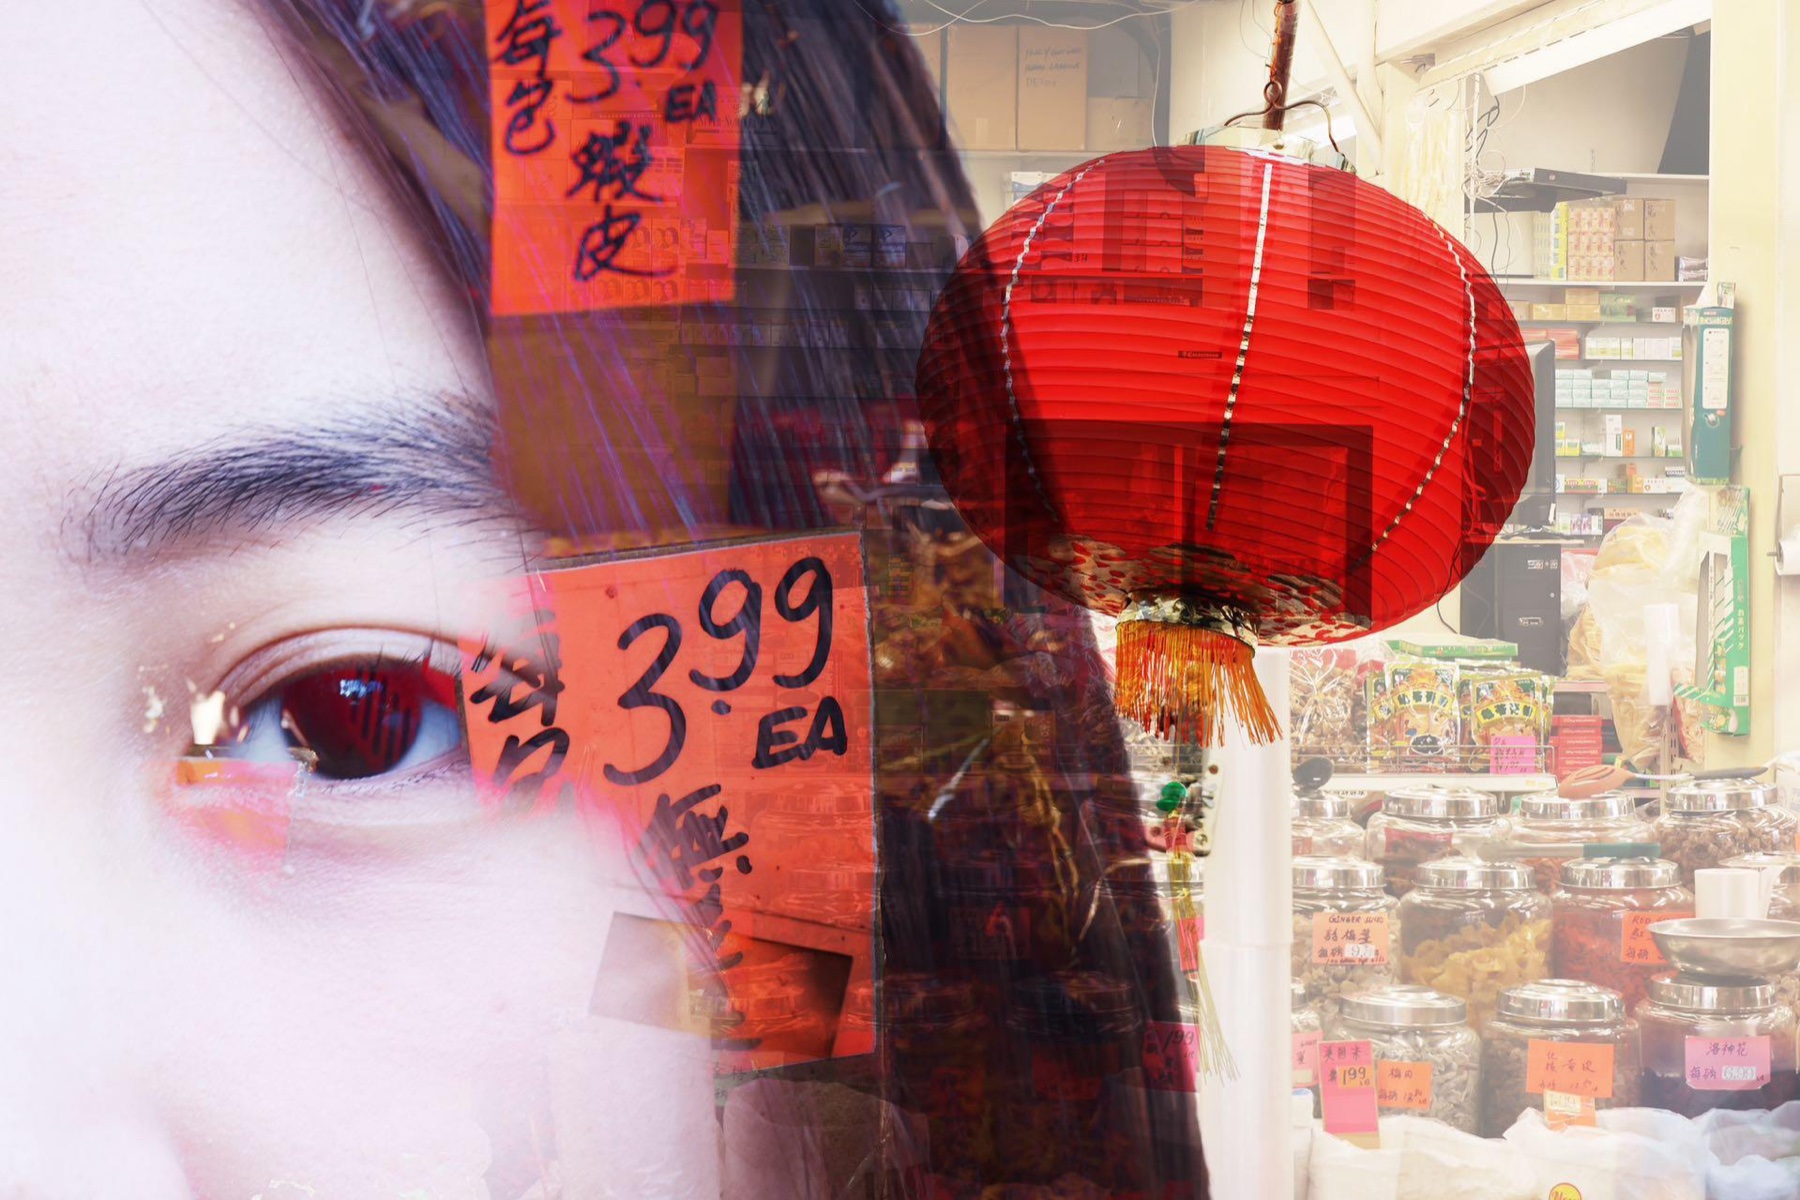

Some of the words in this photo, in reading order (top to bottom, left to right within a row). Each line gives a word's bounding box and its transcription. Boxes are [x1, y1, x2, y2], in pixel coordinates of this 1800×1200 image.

[664, 80, 718, 123] EA
[752, 696, 848, 769] EA
[1632, 915, 1652, 925] RED
